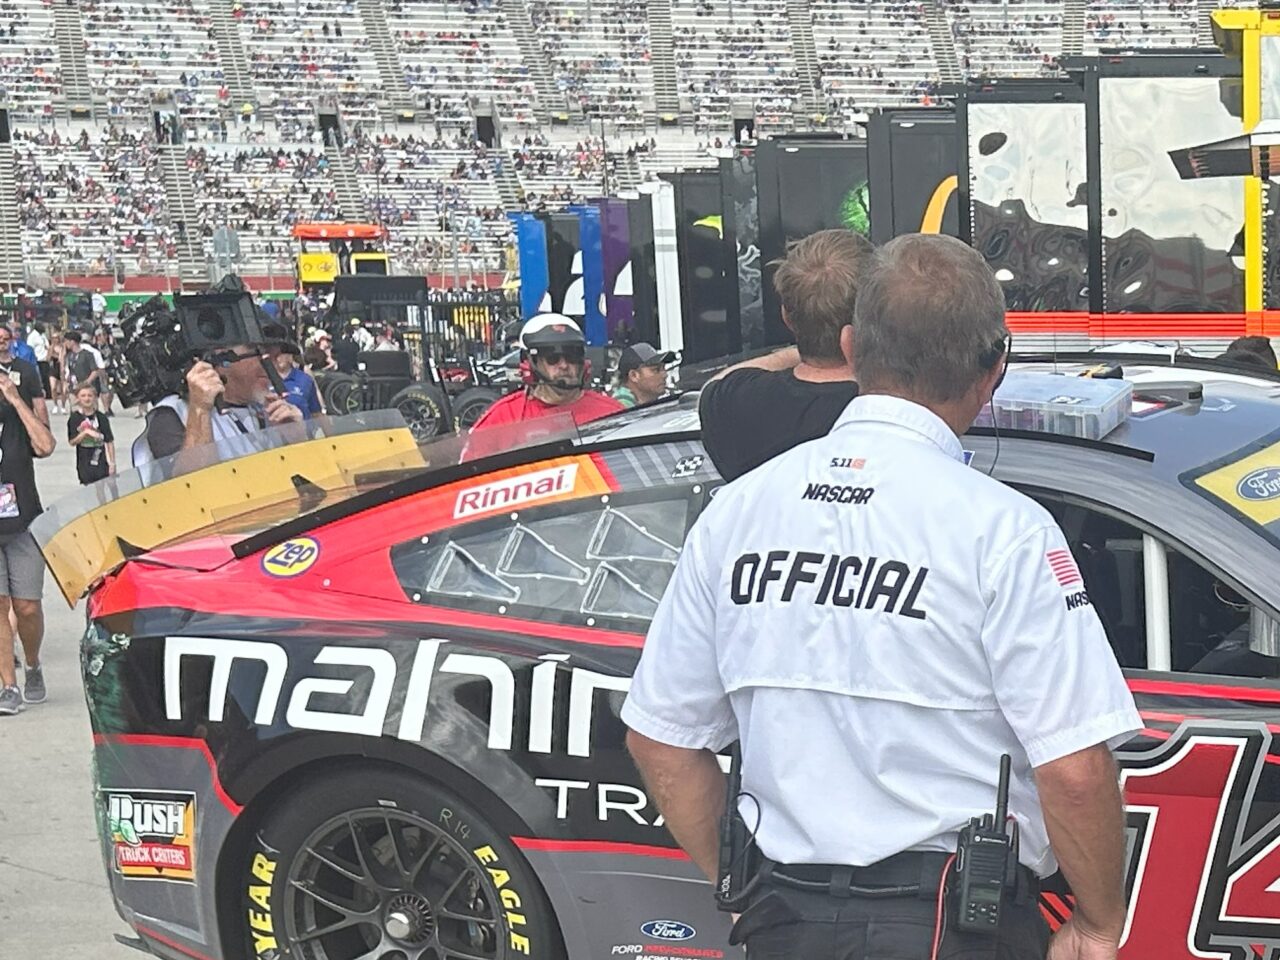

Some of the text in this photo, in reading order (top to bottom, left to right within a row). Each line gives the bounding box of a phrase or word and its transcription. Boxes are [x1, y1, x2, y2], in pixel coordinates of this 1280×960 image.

[458, 469, 567, 514] Rinnai
[801, 483, 875, 504] NASCAR
[730, 551, 929, 619] OFFICIAL
[1066, 591, 1089, 611] NAS
[164, 636, 632, 757] mahin
[535, 778, 662, 827] TR
[119, 846, 152, 862] TRUCK
[474, 845, 530, 955] EAGLE
[611, 945, 643, 955] FORD
